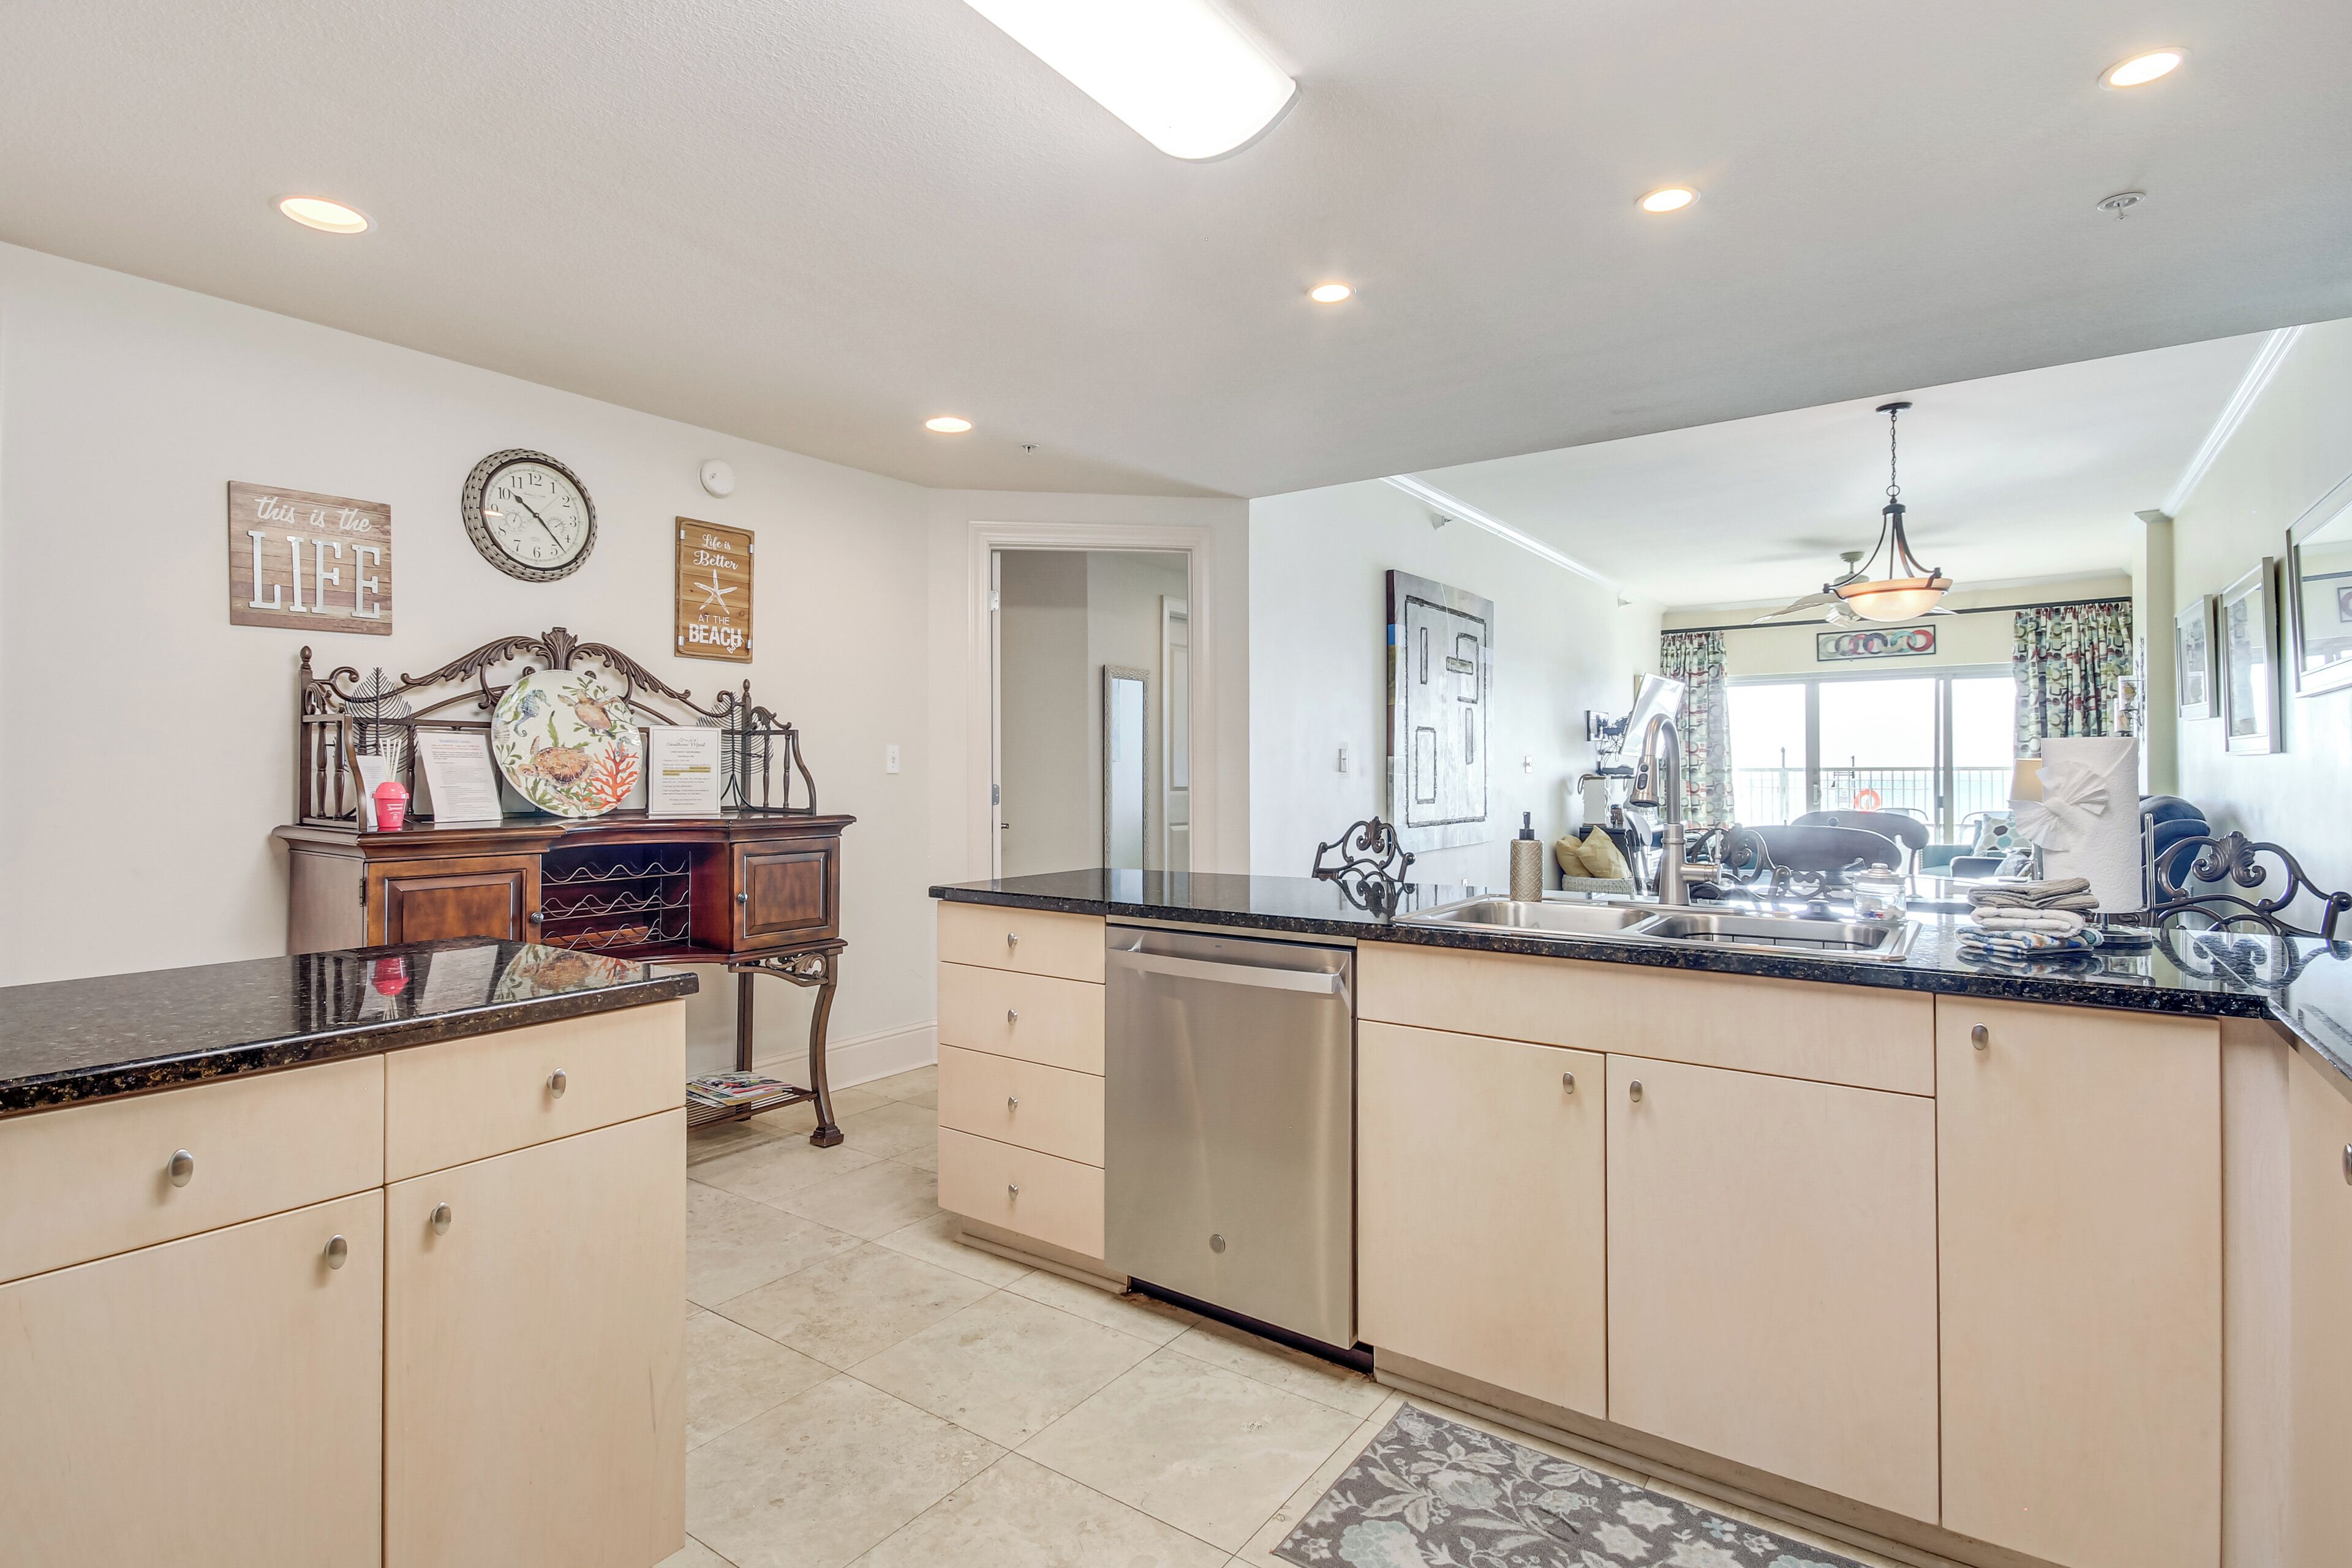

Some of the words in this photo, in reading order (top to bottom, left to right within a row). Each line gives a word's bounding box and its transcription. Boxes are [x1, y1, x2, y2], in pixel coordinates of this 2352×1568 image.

[510, 475, 522, 489] 11
[527, 473, 541, 486] 12
[497, 487, 511, 500] 10
[550, 482, 555, 494] 1
[562, 496, 570, 508] 2
[254, 496, 295, 524] this
[309, 509, 325, 527] is
[337, 508, 372, 532] the
[570, 516, 577, 528] 3
[498, 526, 507, 537] 8
[514, 540, 521, 552] 7
[702, 533, 723, 550] Life
[723, 541, 731, 550] is
[533, 546, 541, 559] 6
[551, 544, 558, 556] 5
[693, 550, 738, 570] Better
[247, 530, 380, 619] LIFE
[698, 614, 710, 624] AT
[713, 616, 730, 625] THE
[688, 623, 742, 647] BEACH
